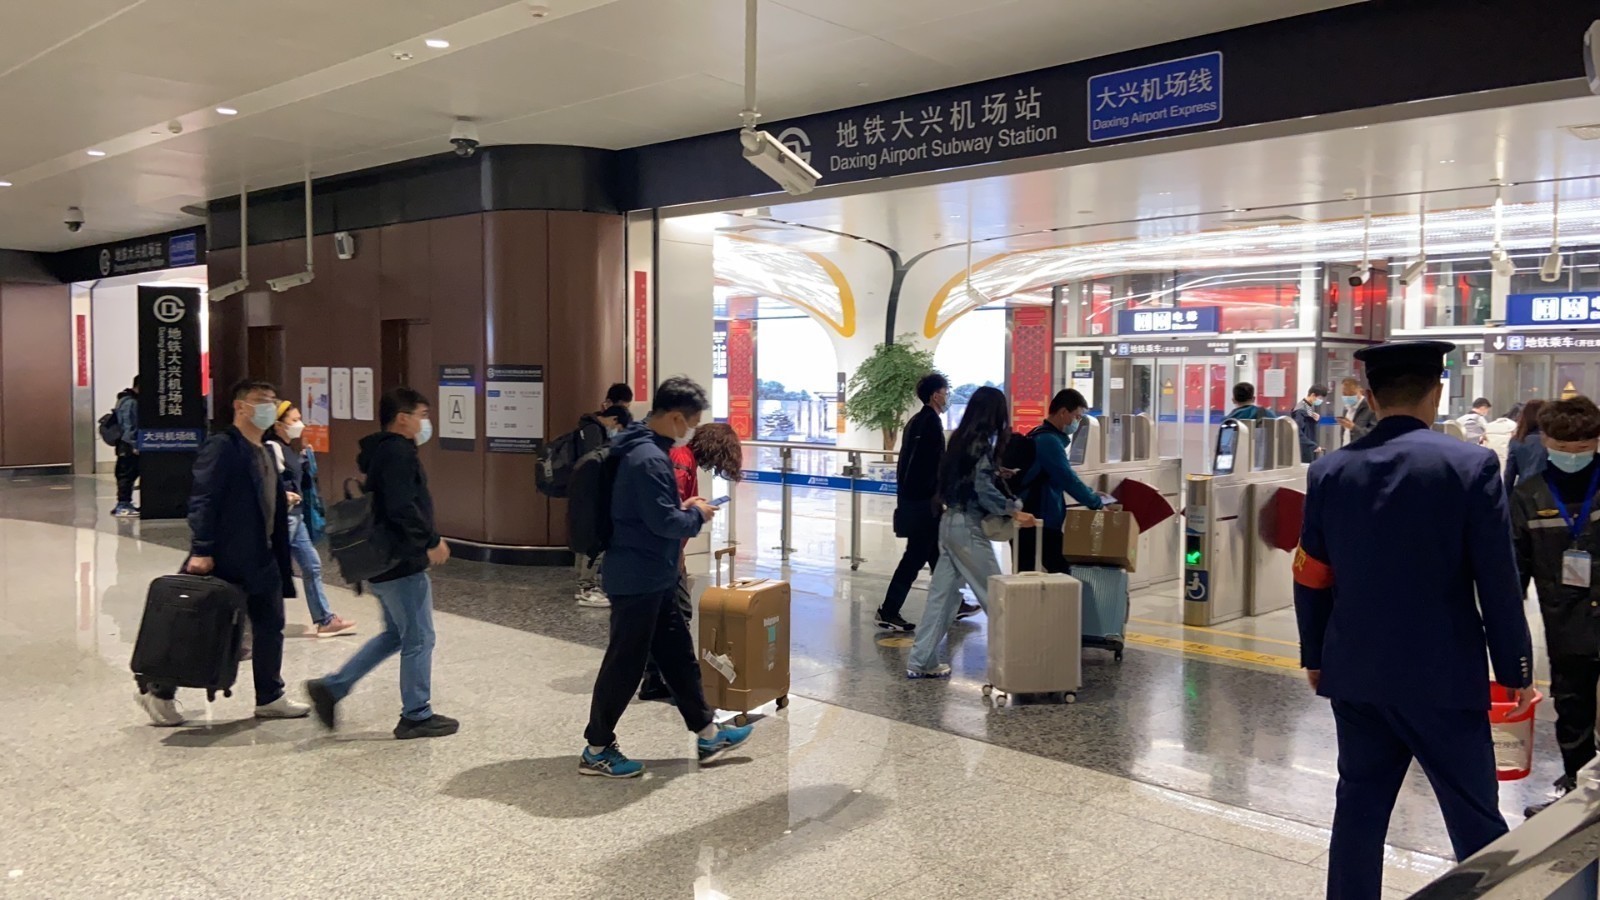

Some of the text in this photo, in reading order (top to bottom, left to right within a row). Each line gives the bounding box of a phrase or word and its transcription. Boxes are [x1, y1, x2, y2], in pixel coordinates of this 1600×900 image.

[1096, 68, 1213, 111] 大兴机场线
[836, 87, 1042, 148] 地铁大兴机场站
[1093, 102, 1217, 130] Daxing Airport Express
[830, 126, 1057, 171] Daxing Airport Subway Station
[157, 326, 167, 416] Daxing Airport Subway Station
[167, 327, 182, 416] 地铁大兴机场站
[452, 399, 462, 419] A
[143, 431, 197, 441] 大兴机场线
